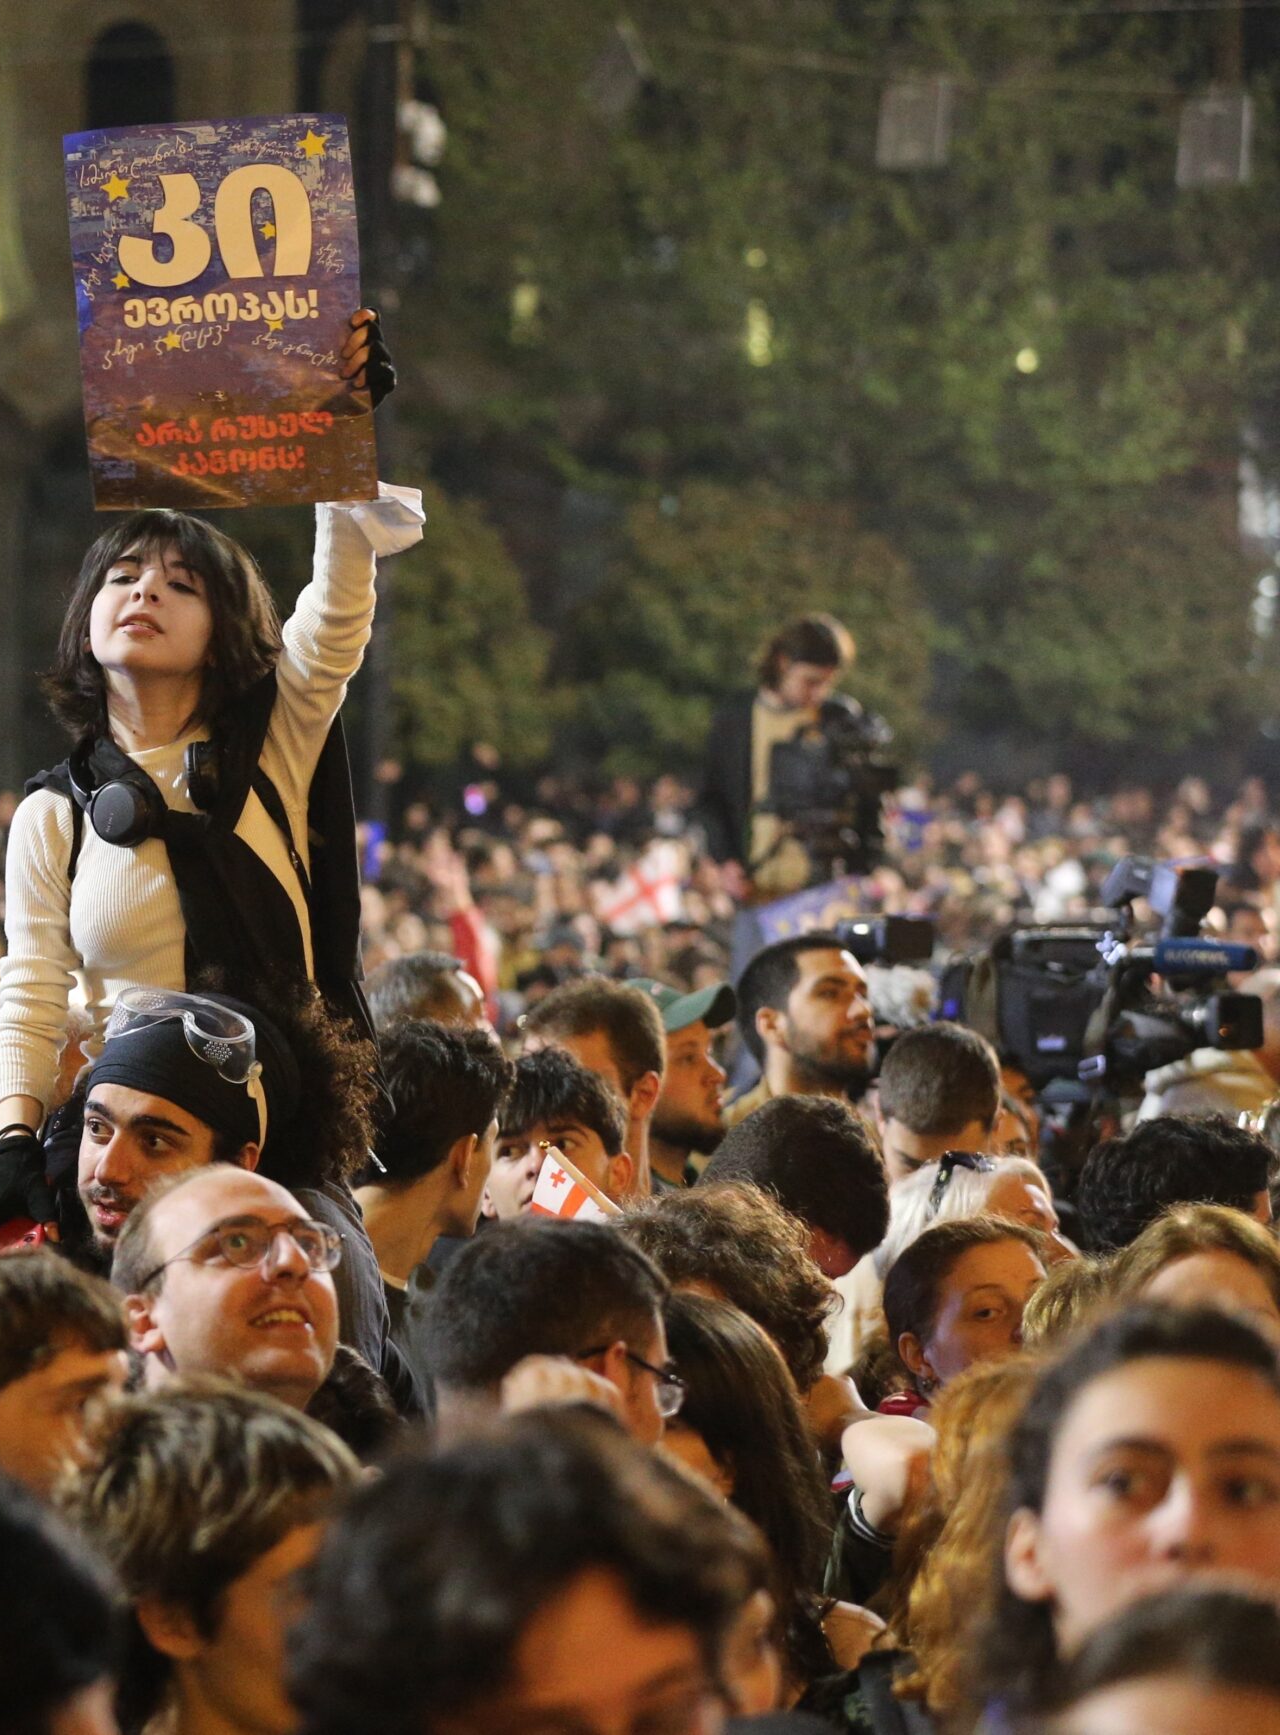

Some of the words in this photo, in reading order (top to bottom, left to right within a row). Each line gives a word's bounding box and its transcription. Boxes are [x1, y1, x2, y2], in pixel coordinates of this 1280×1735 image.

[118, 163, 312, 287] კი
[123, 289, 320, 329] ევროპას!
[135, 417, 204, 447] არა
[209, 410, 335, 442] რუსულ
